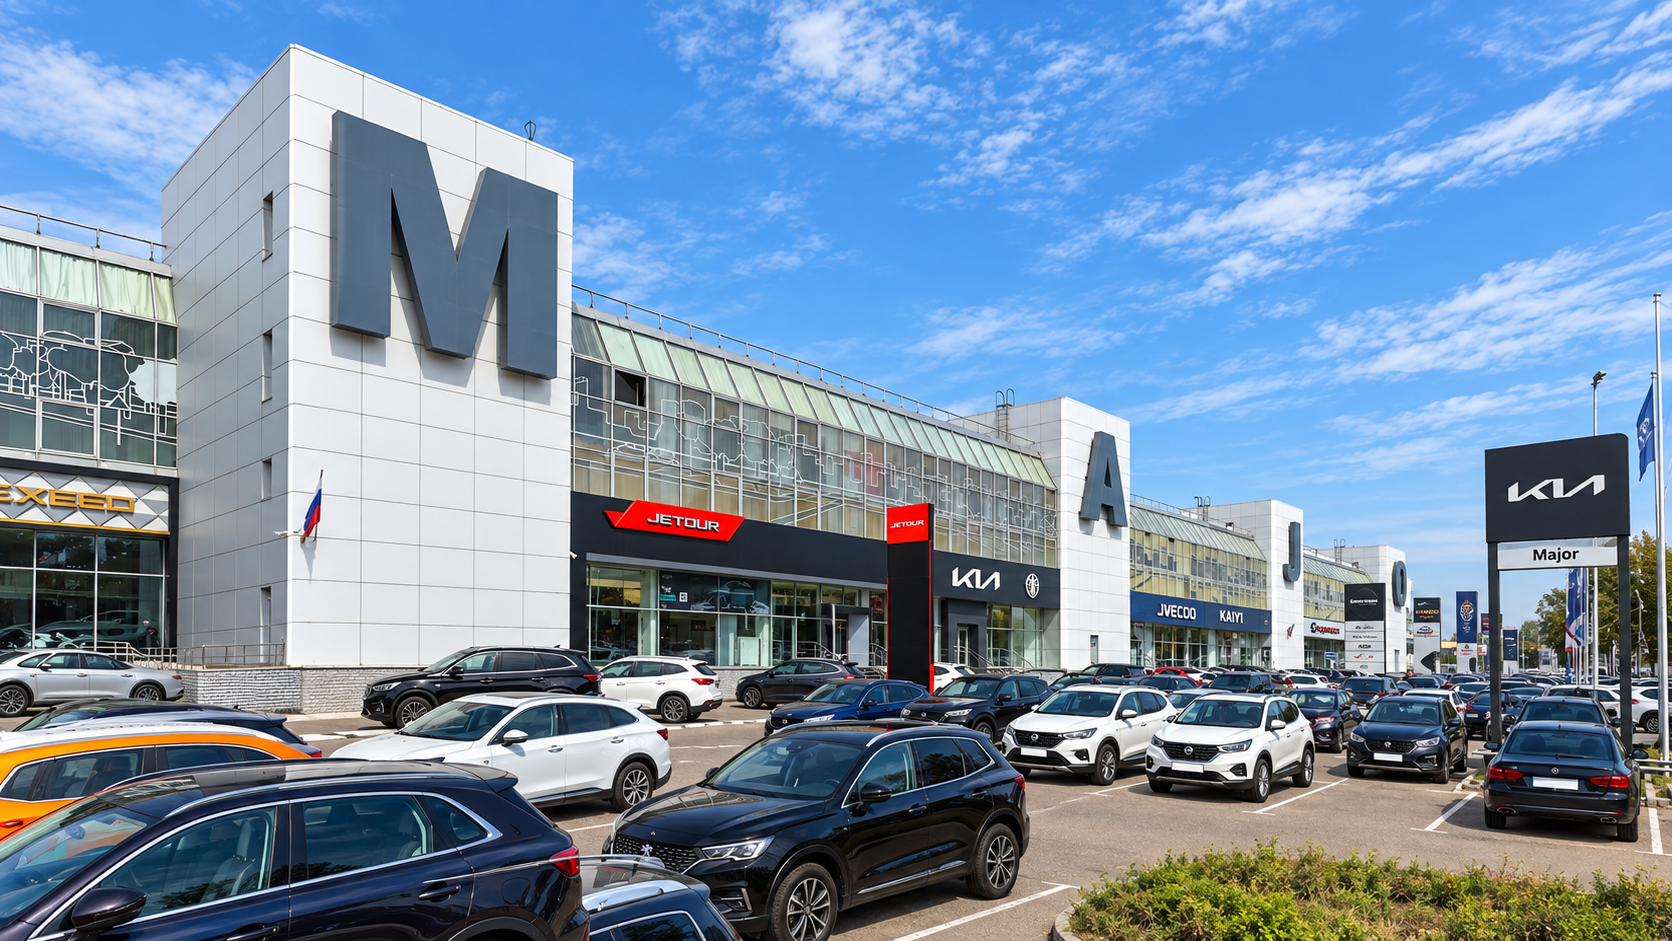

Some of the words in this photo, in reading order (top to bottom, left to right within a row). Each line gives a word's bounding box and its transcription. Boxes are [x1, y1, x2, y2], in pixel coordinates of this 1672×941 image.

[331, 110, 558, 380] M
[1079, 430, 1128, 527] A
[647, 513, 719, 533] JETOUR
[890, 519, 924, 529] JETOUR
[1282, 521, 1301, 582] J
[1533, 548, 1580, 563] Major
[1392, 560, 1408, 607] O
